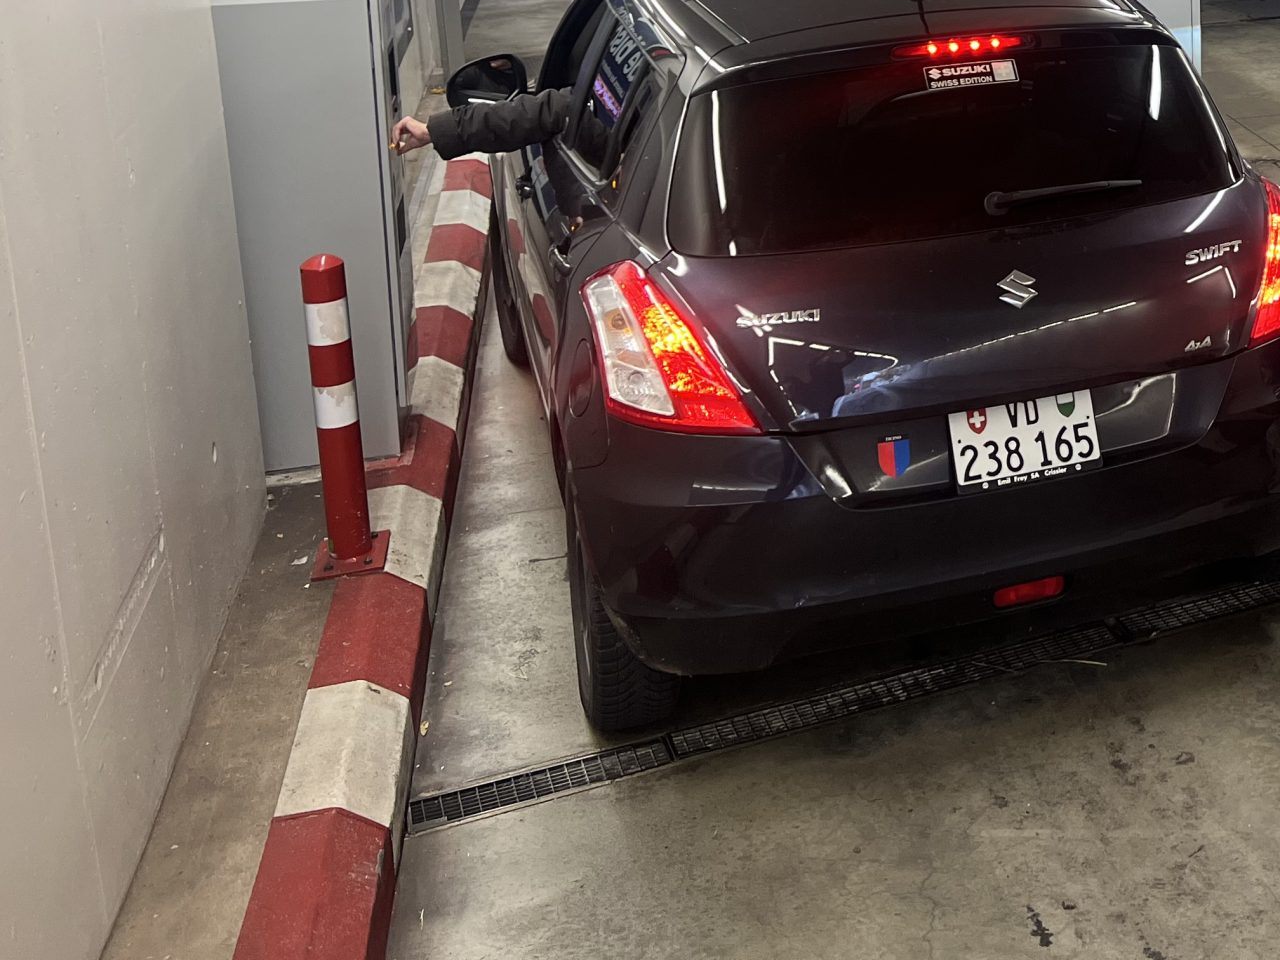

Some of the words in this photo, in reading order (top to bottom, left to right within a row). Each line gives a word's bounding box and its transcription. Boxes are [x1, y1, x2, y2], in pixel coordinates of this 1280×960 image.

[942, 64, 991, 77] SUZUKI
[930, 80, 959, 89] SWISS
[960, 76, 993, 85] EDITION
[1185, 240, 1242, 265] SWIFT
[736, 308, 820, 328] SUZUKI
[1006, 400, 1039, 428] VD
[960, 436, 1024, 483] 238
[1035, 421, 1094, 467] 165
[997, 477, 1011, 486] Emil
[1014, 475, 1028, 484] Frey
